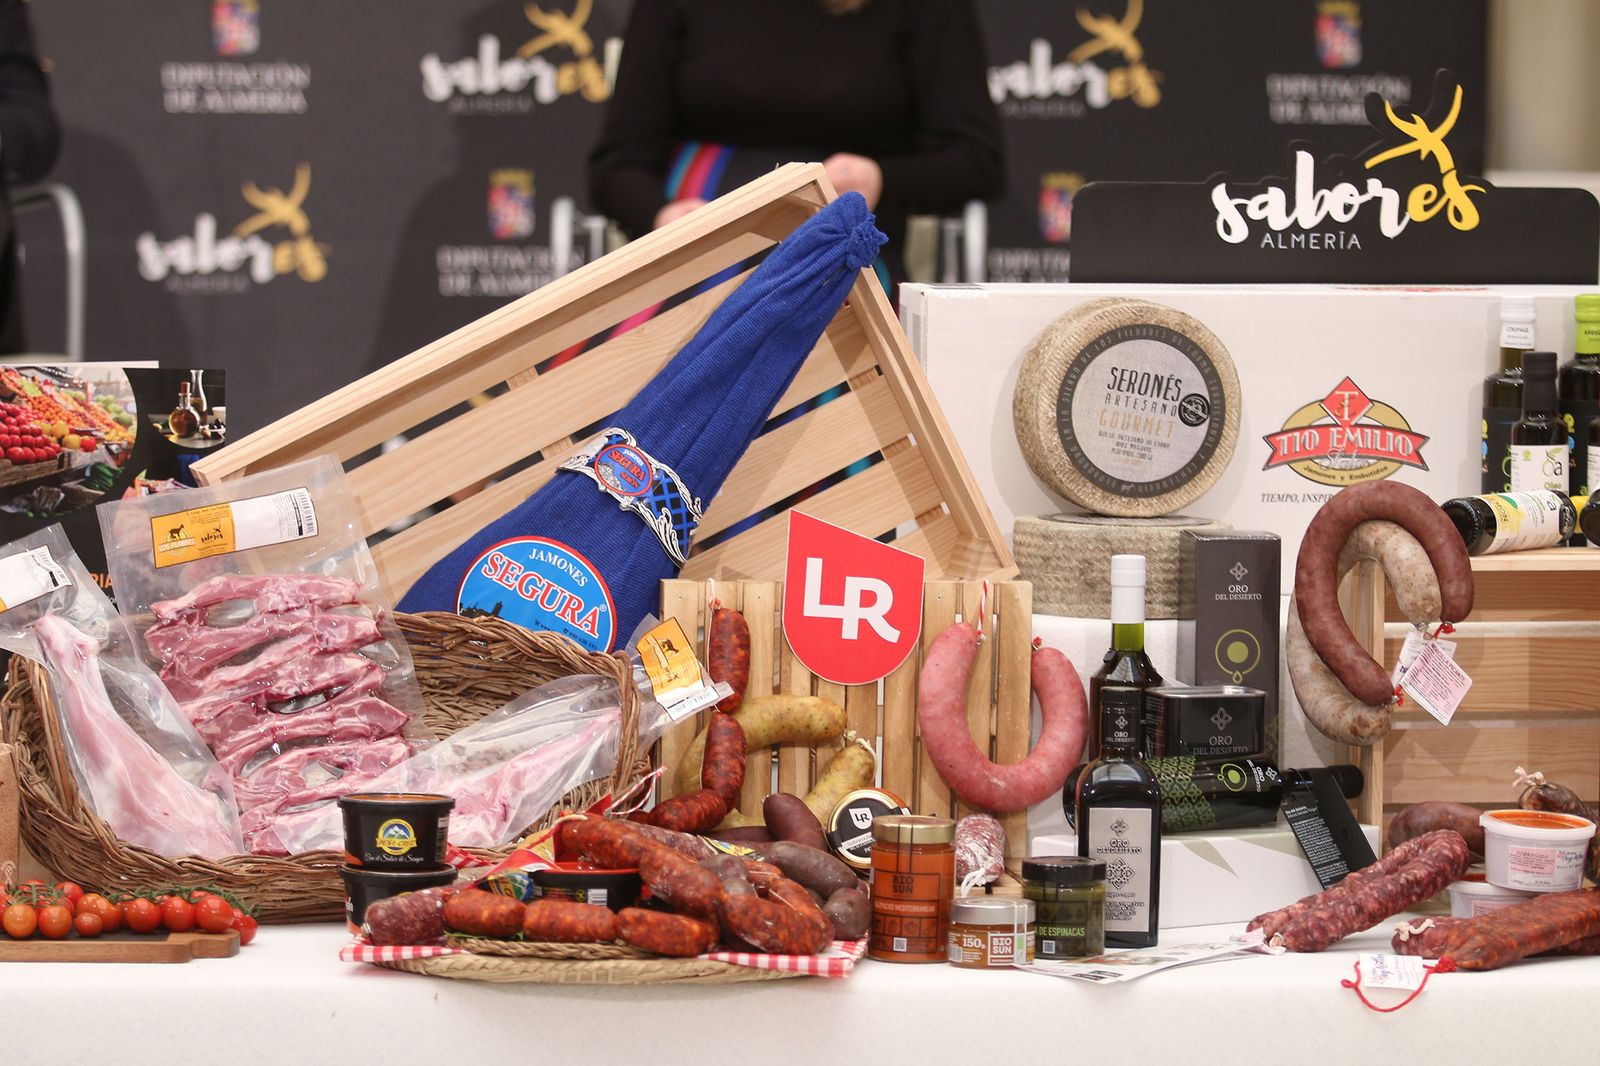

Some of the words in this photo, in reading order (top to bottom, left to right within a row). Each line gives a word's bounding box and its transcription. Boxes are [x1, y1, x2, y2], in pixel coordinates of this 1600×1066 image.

[1211, 150, 1487, 244] sabores
[1260, 231, 1362, 250] ALMERÍA
[1093, 336, 1112, 352] LOS
[1107, 367, 1182, 402] SERONÉS
[1105, 393, 1178, 417] ARTESANO
[1100, 409, 1177, 439] GOURMET
[1330, 427, 1414, 457] EMILIO
[608, 450, 645, 481] SEGURA
[1303, 465, 1336, 480] Jamones
[1349, 466, 1389, 480] Embutidos
[1261, 493, 1299, 504] TIEMPO,
[529, 548, 588, 587] JAMONES
[481, 551, 599, 639] SEGURA
[1228, 585, 1249, 593] ORO
[803, 557, 901, 643] LR
[1209, 736, 1233, 746] ORO
[1193, 747, 1208, 755] DEL
[1211, 746, 1249, 755] DESIERTO
[1256, 766, 1265, 783] ORO
[854, 812, 871, 823] LR
[1110, 839, 1129, 847] ORO
[893, 875, 913, 883] BIO
[893, 885, 913, 894] SUN
[1039, 927, 1047, 936] DE
[1048, 927, 1085, 937] ESPINACAS
[992, 937, 1012, 946] BIO
[992, 946, 1012, 954] SUN
